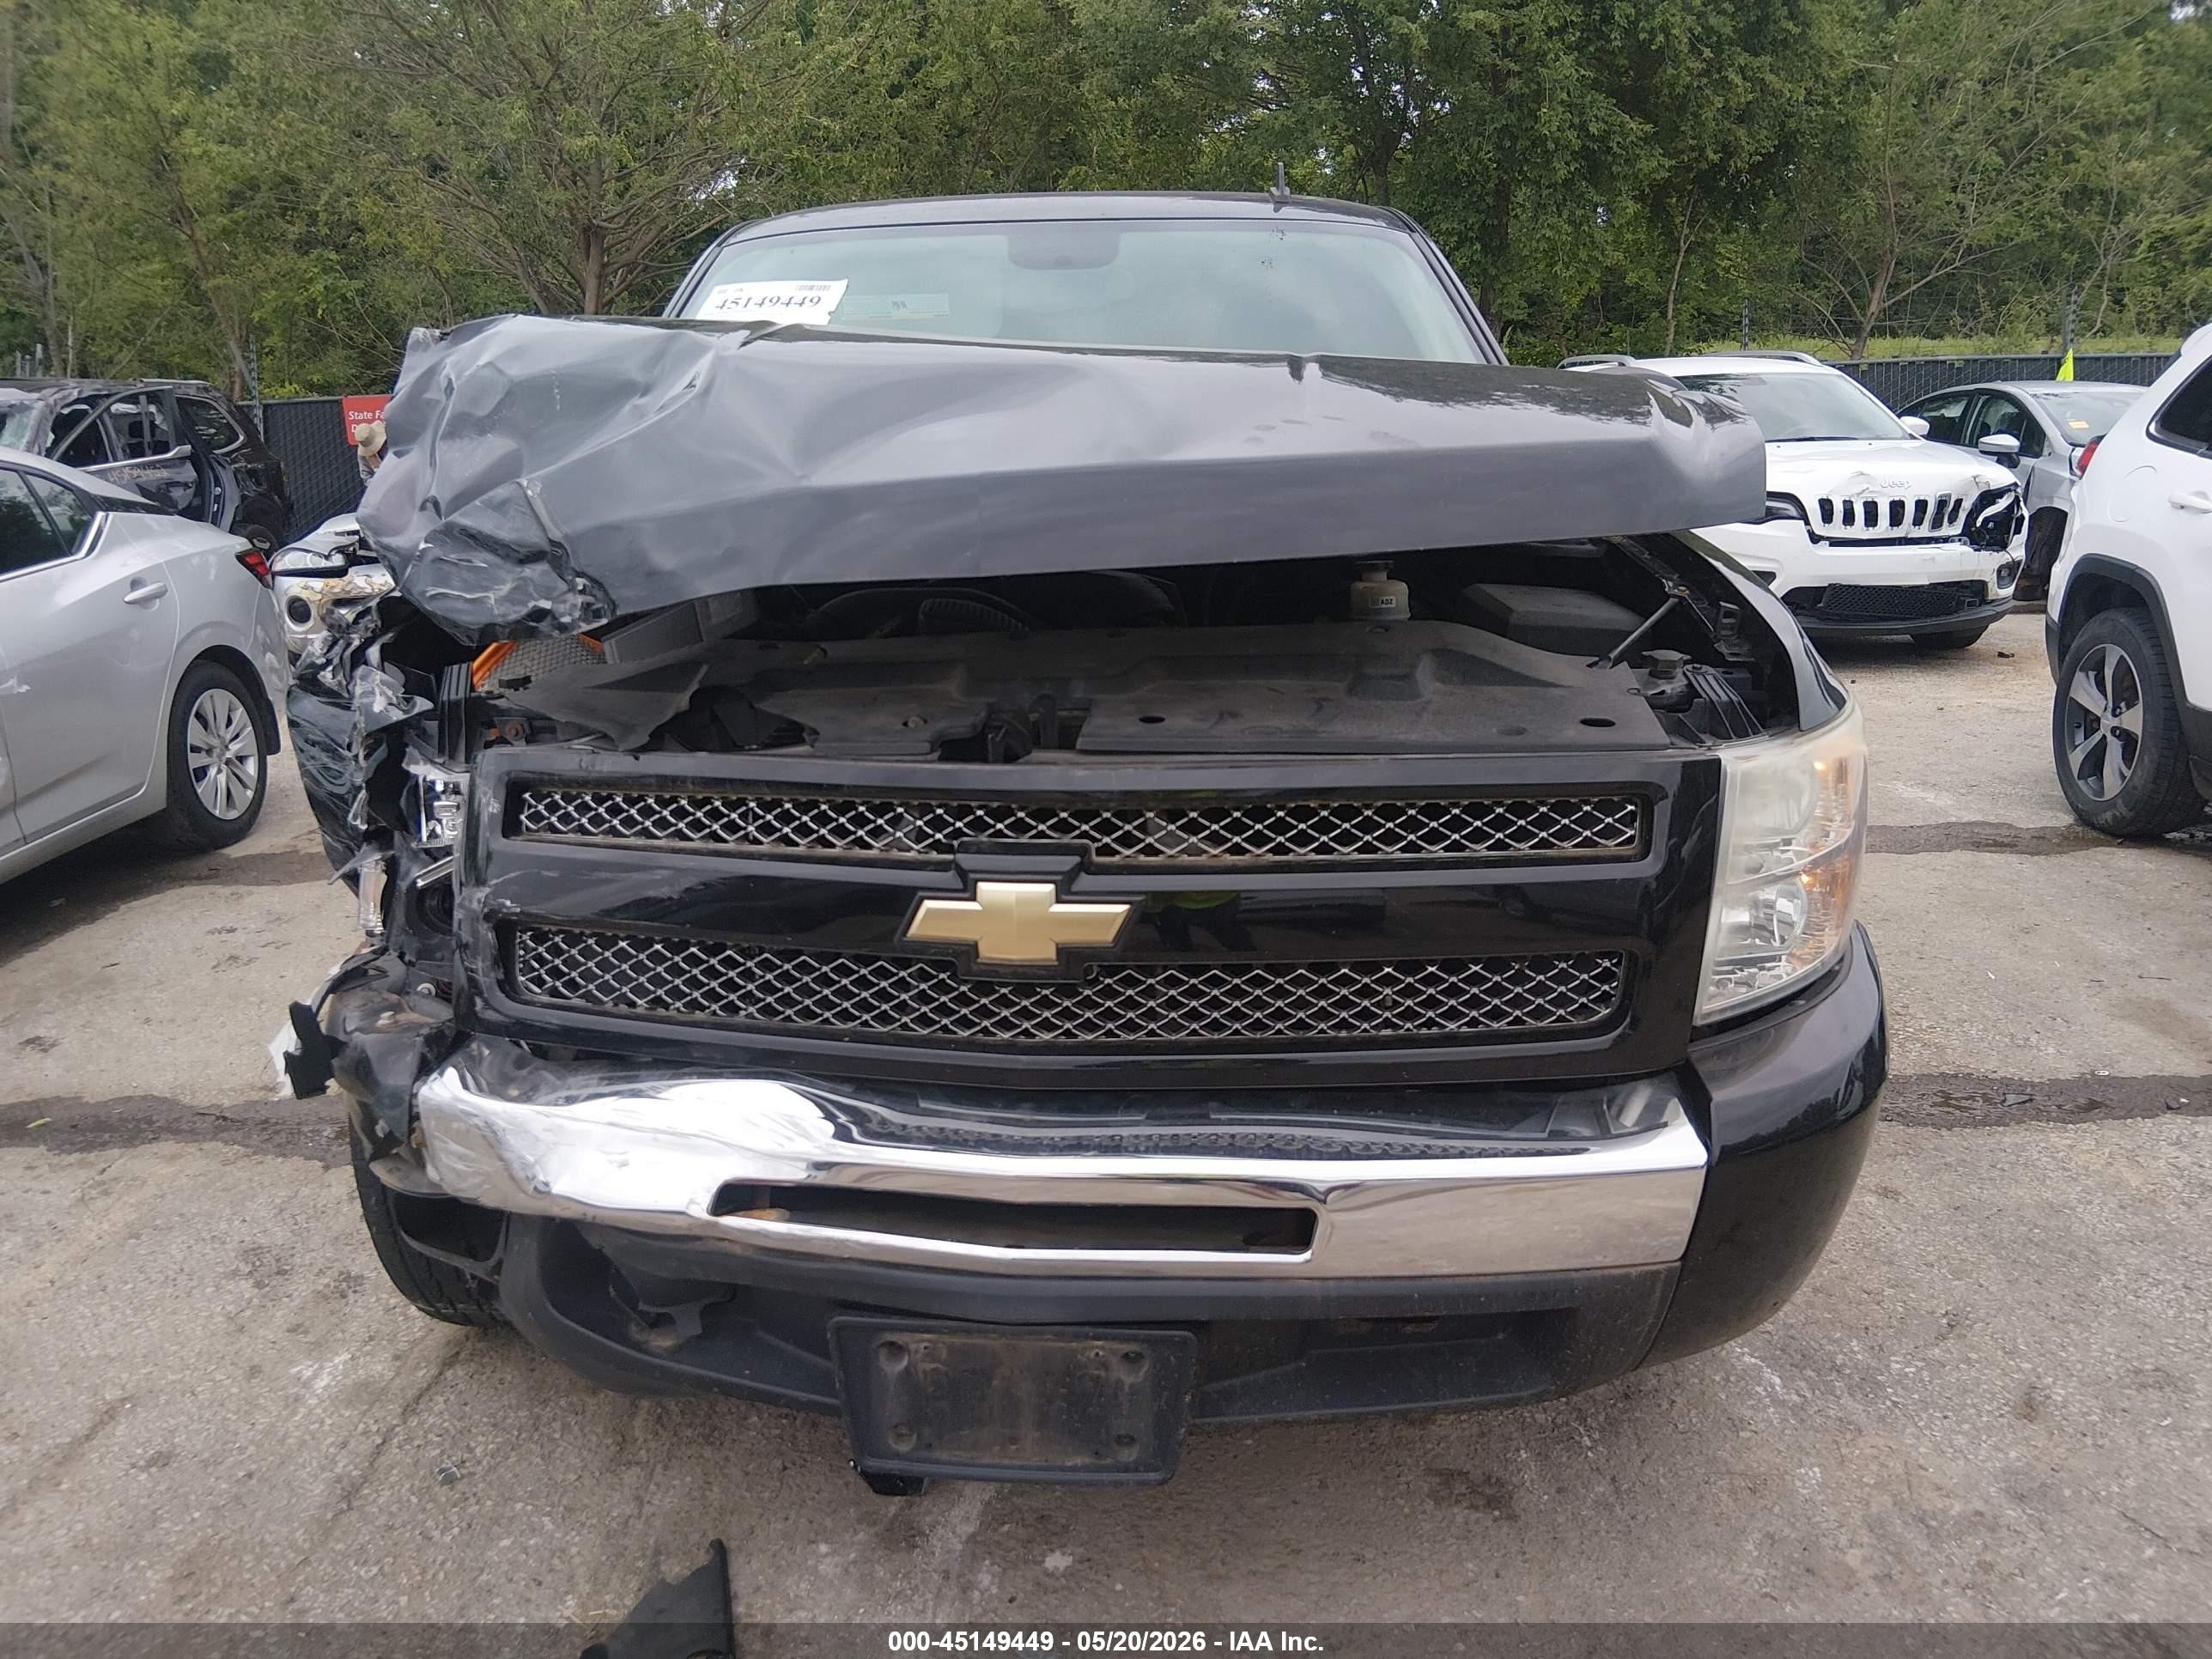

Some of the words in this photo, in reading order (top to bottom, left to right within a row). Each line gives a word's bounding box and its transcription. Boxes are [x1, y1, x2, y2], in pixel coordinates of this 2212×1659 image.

[714, 295, 822, 310] 45149449
[349, 410, 373, 420] State
[1881, 475, 1912, 489] Jeep
